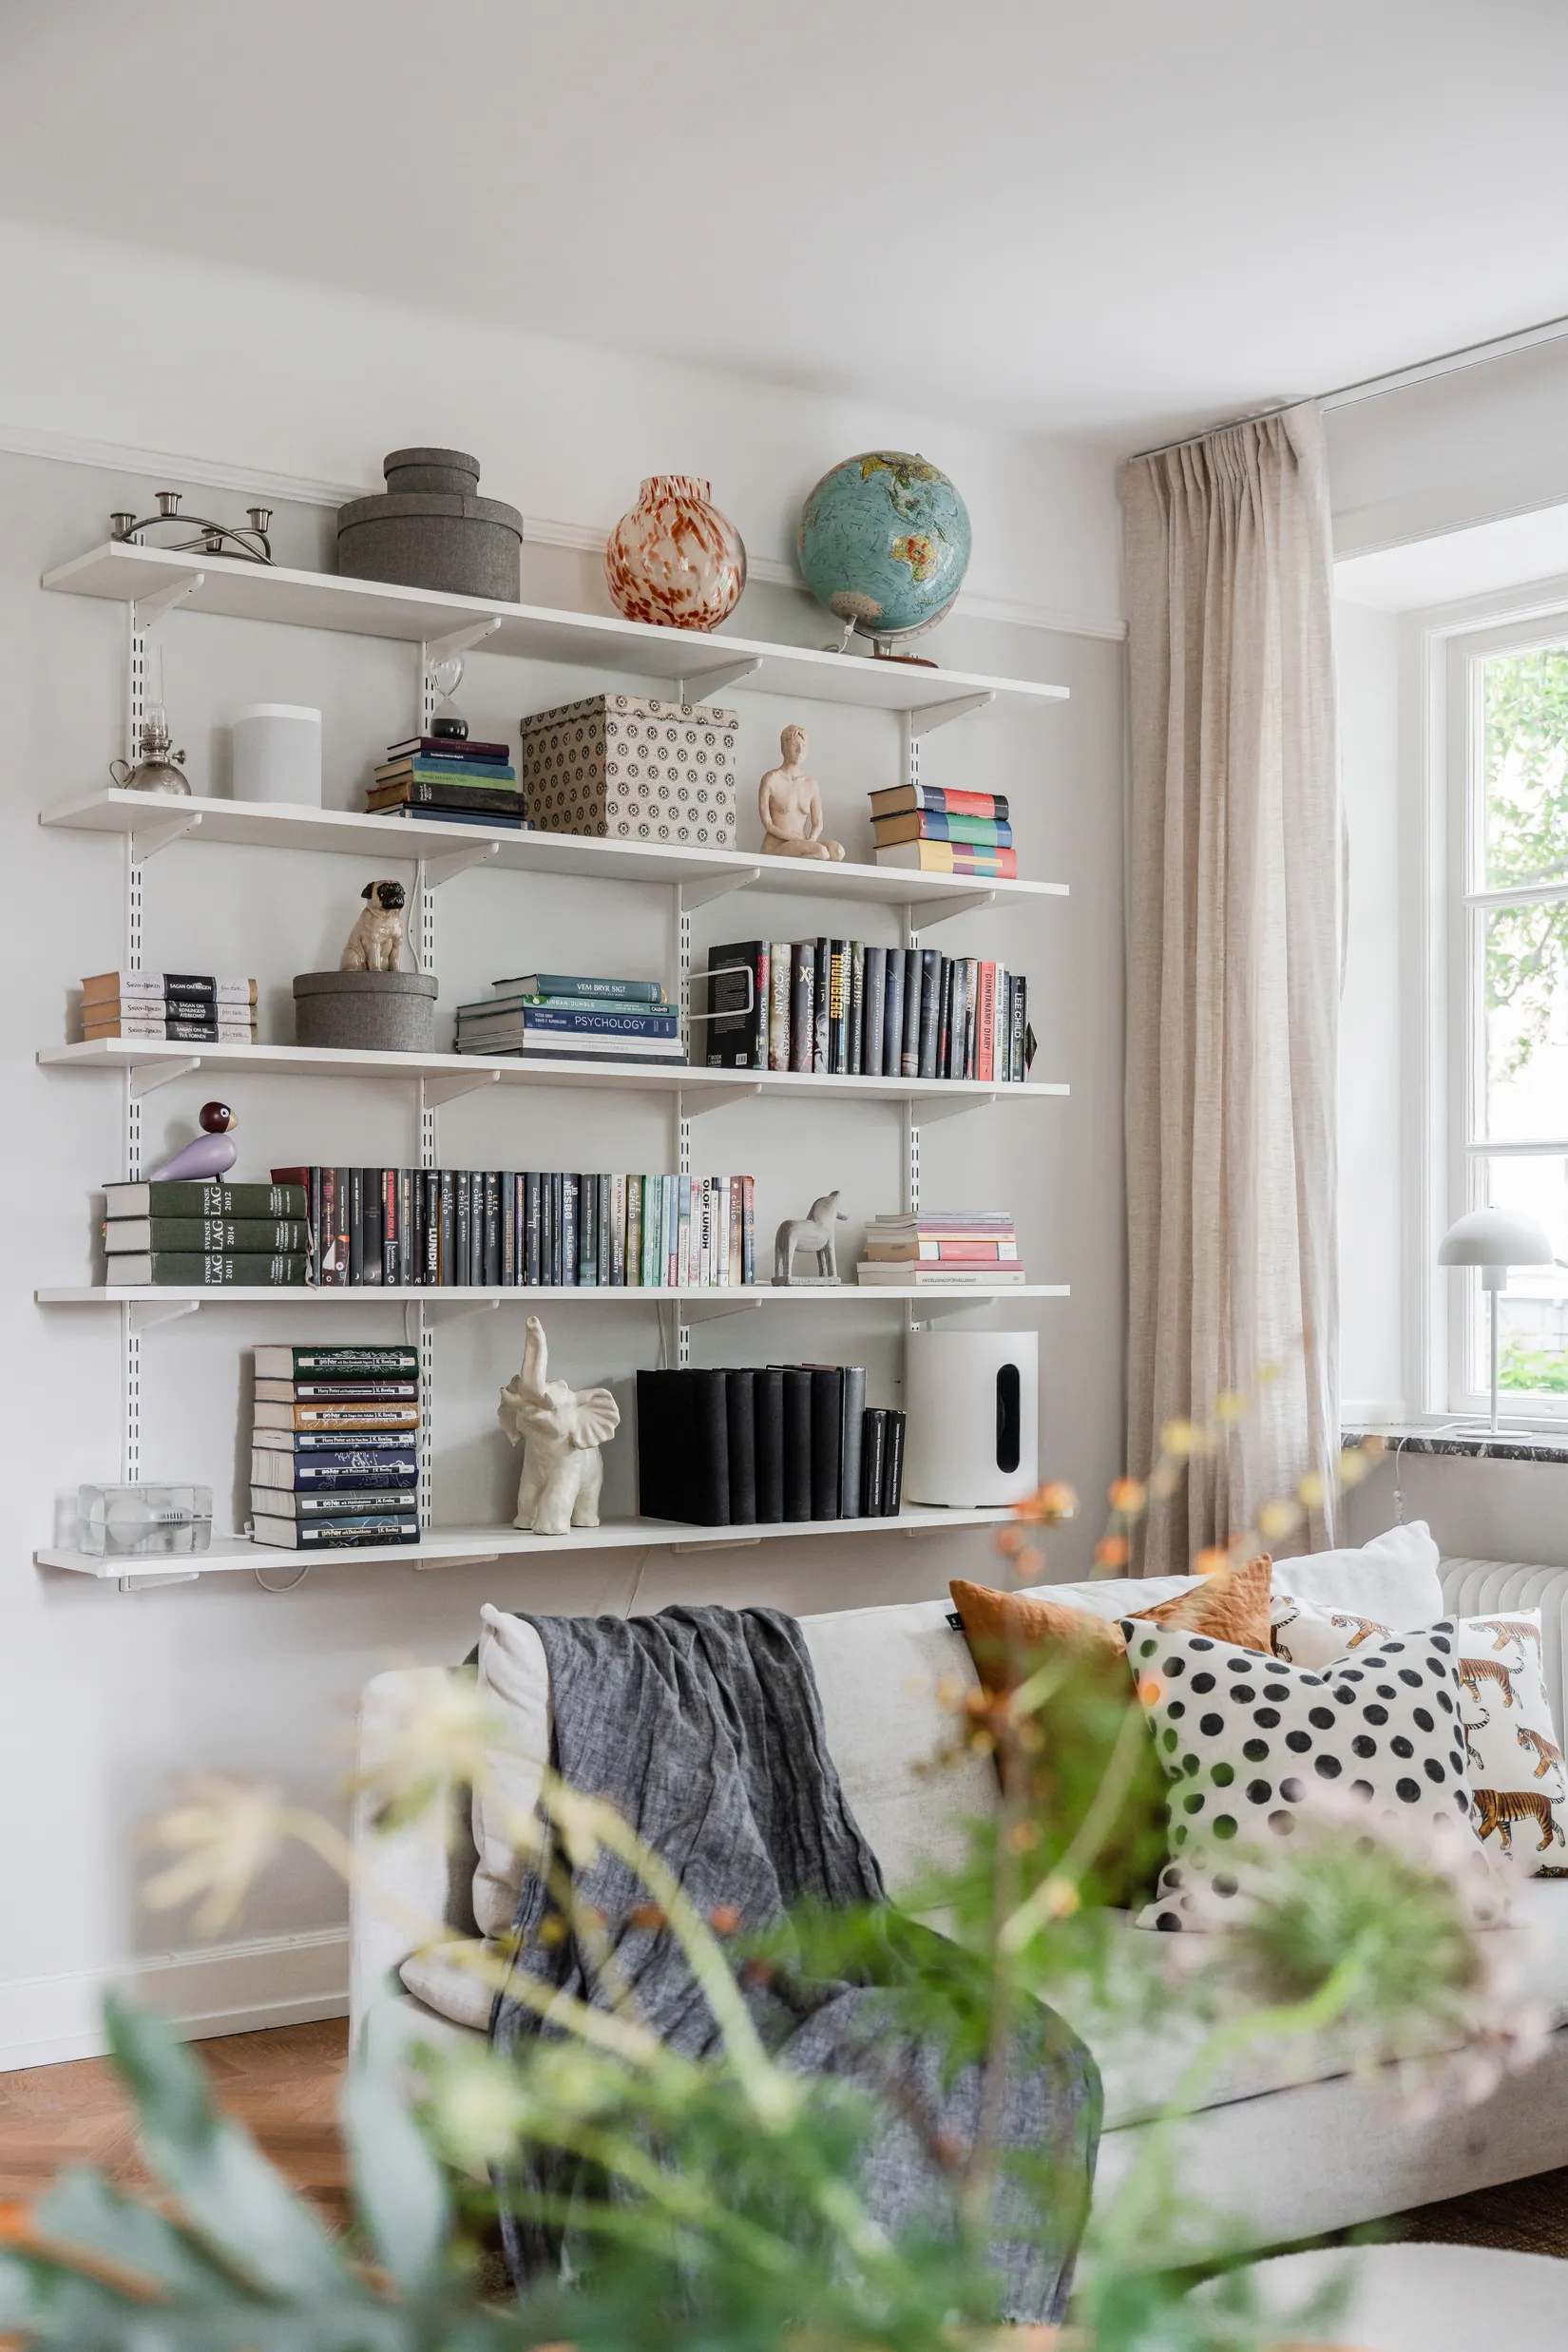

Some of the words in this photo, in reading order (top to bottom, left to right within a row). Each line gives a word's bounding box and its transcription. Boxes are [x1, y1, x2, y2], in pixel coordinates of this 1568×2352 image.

[593, 984, 609, 992] BRYR
[774, 966, 783, 1015] KOKAIN
[831, 953, 844, 1019] THUNBERG
[985, 973, 993, 1024] GUANTÁNAMO
[575, 1016, 646, 1030] PSYCHOLOGY
[572, 1185, 578, 1195] JO
[617, 1178, 621, 1187] EN
[211, 1186, 221, 1215] LAG
[564, 1180, 572, 1219] NESBØ
[527, 1209, 540, 1229] Schepp
[213, 1220, 223, 1251] LAG
[429, 1228, 437, 1271] LUNDH
[212, 1254, 222, 1284] LAG
